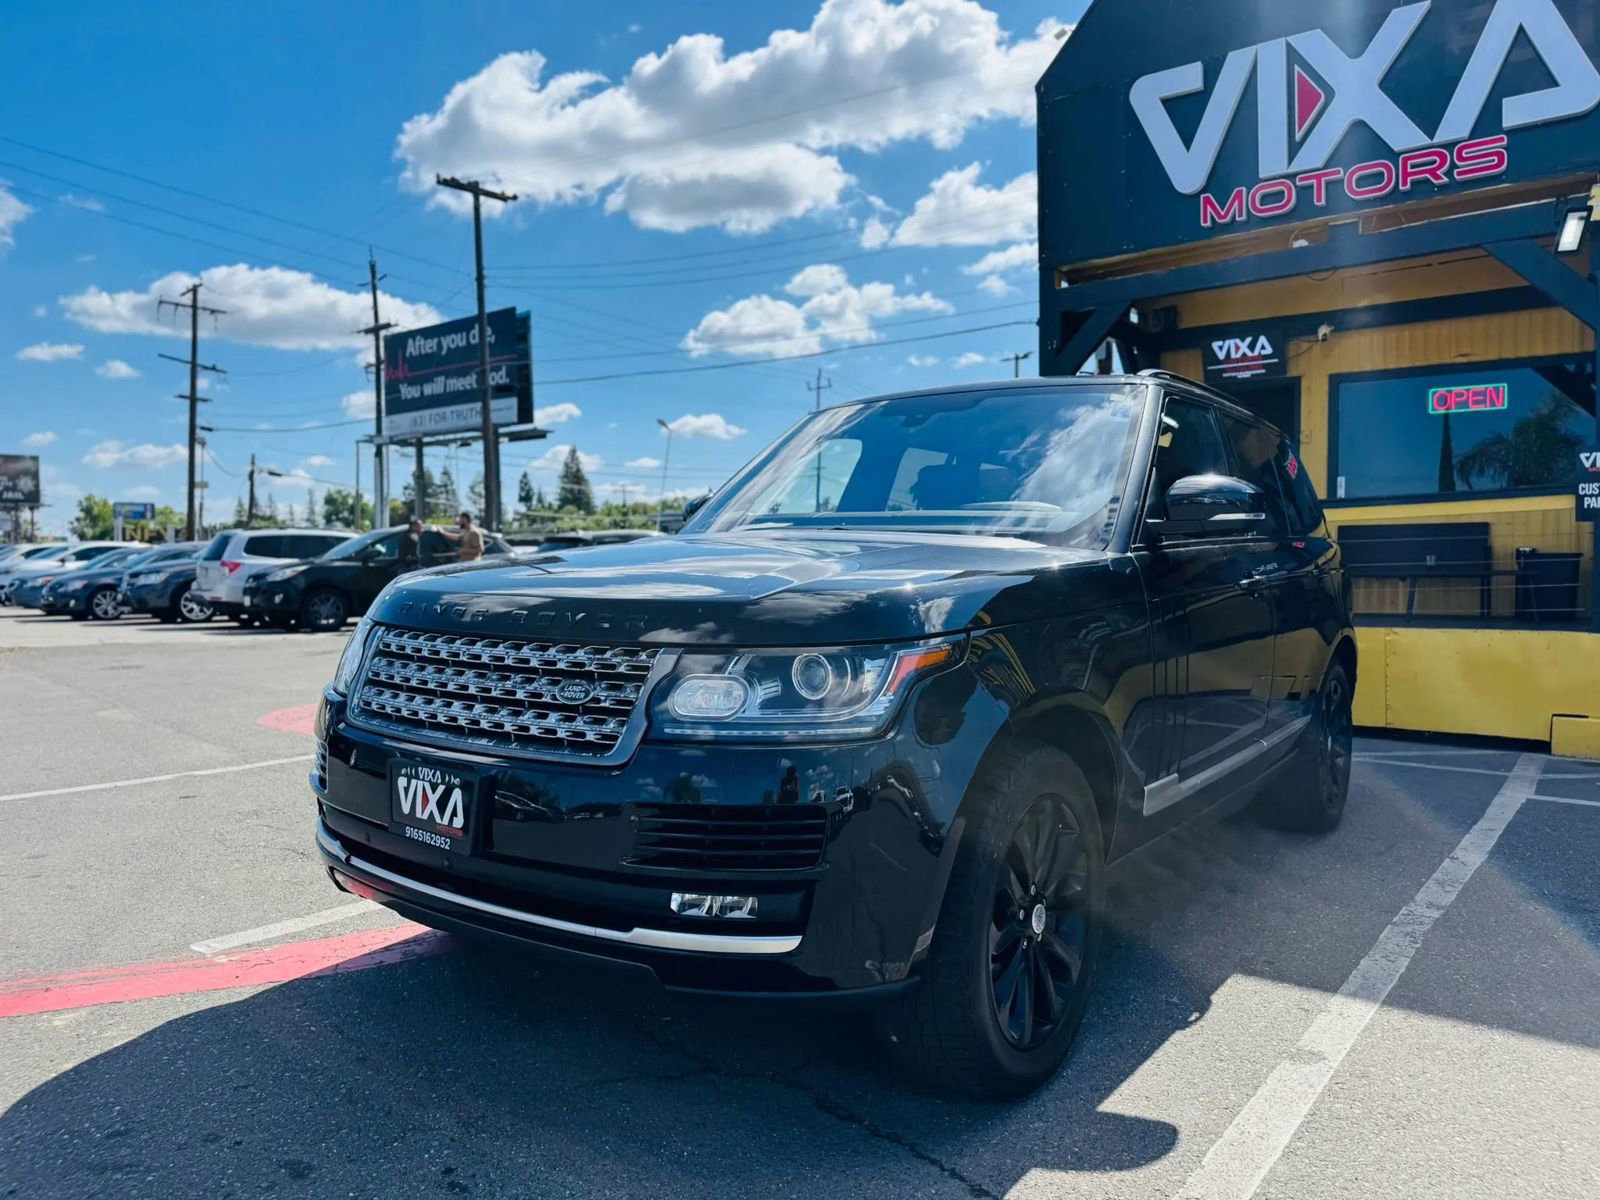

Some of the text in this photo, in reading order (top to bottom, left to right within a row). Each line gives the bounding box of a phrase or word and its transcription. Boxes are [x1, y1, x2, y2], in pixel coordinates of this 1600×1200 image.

[1128, 0, 1600, 195] VIXA
[1200, 134, 1508, 228] MOTORS
[405, 323, 496, 358] After you de,
[1211, 334, 1274, 361] VIXA
[399, 365, 511, 401] You will meet od.
[1432, 386, 1505, 412] OPEN
[1578, 482, 1600, 496] CUS
[563, 691, 586, 699] ROVER
[418, 766, 442, 784] VIXA
[397, 776, 465, 829] VIXA
[405, 826, 451, 850] 9165162952
